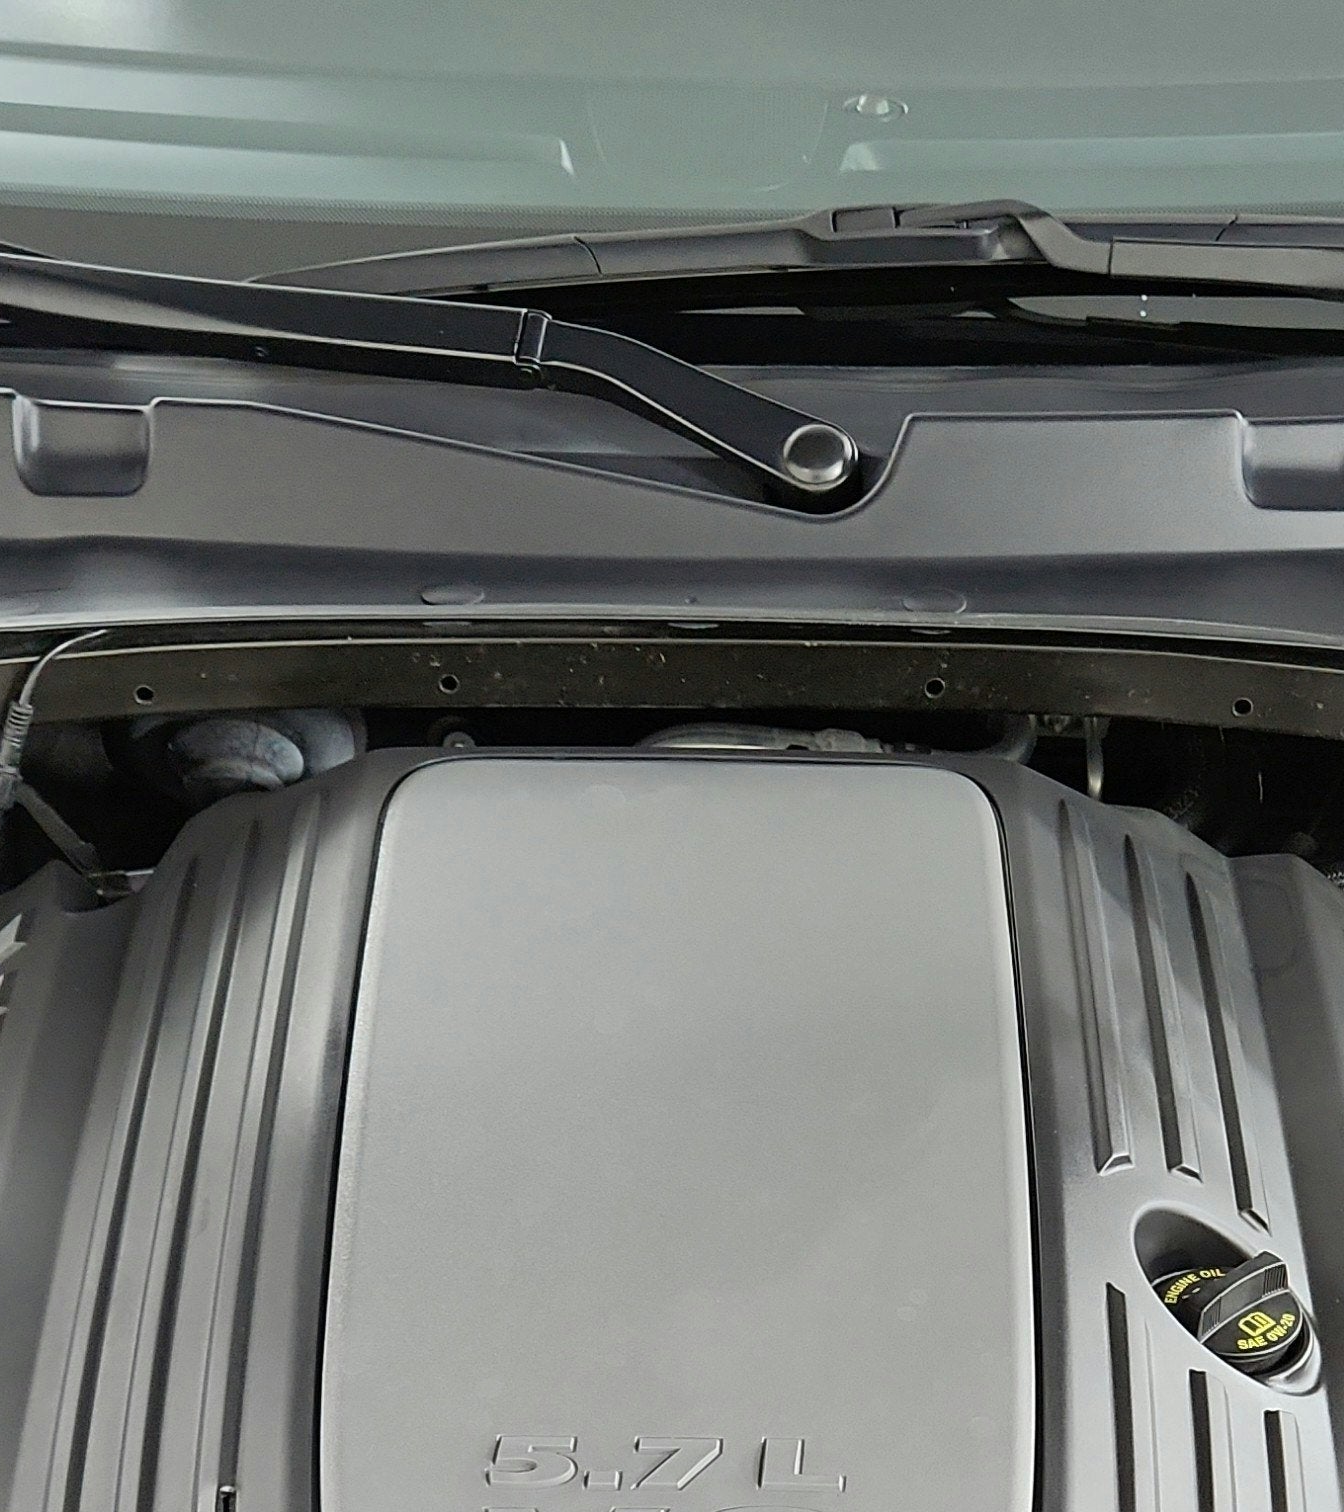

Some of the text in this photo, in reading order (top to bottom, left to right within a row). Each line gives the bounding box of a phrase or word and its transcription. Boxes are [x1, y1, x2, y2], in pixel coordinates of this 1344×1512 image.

[1164, 1268, 1227, 1304] ENGINE OIL
[1237, 1313, 1296, 1350] SAE 0W-20
